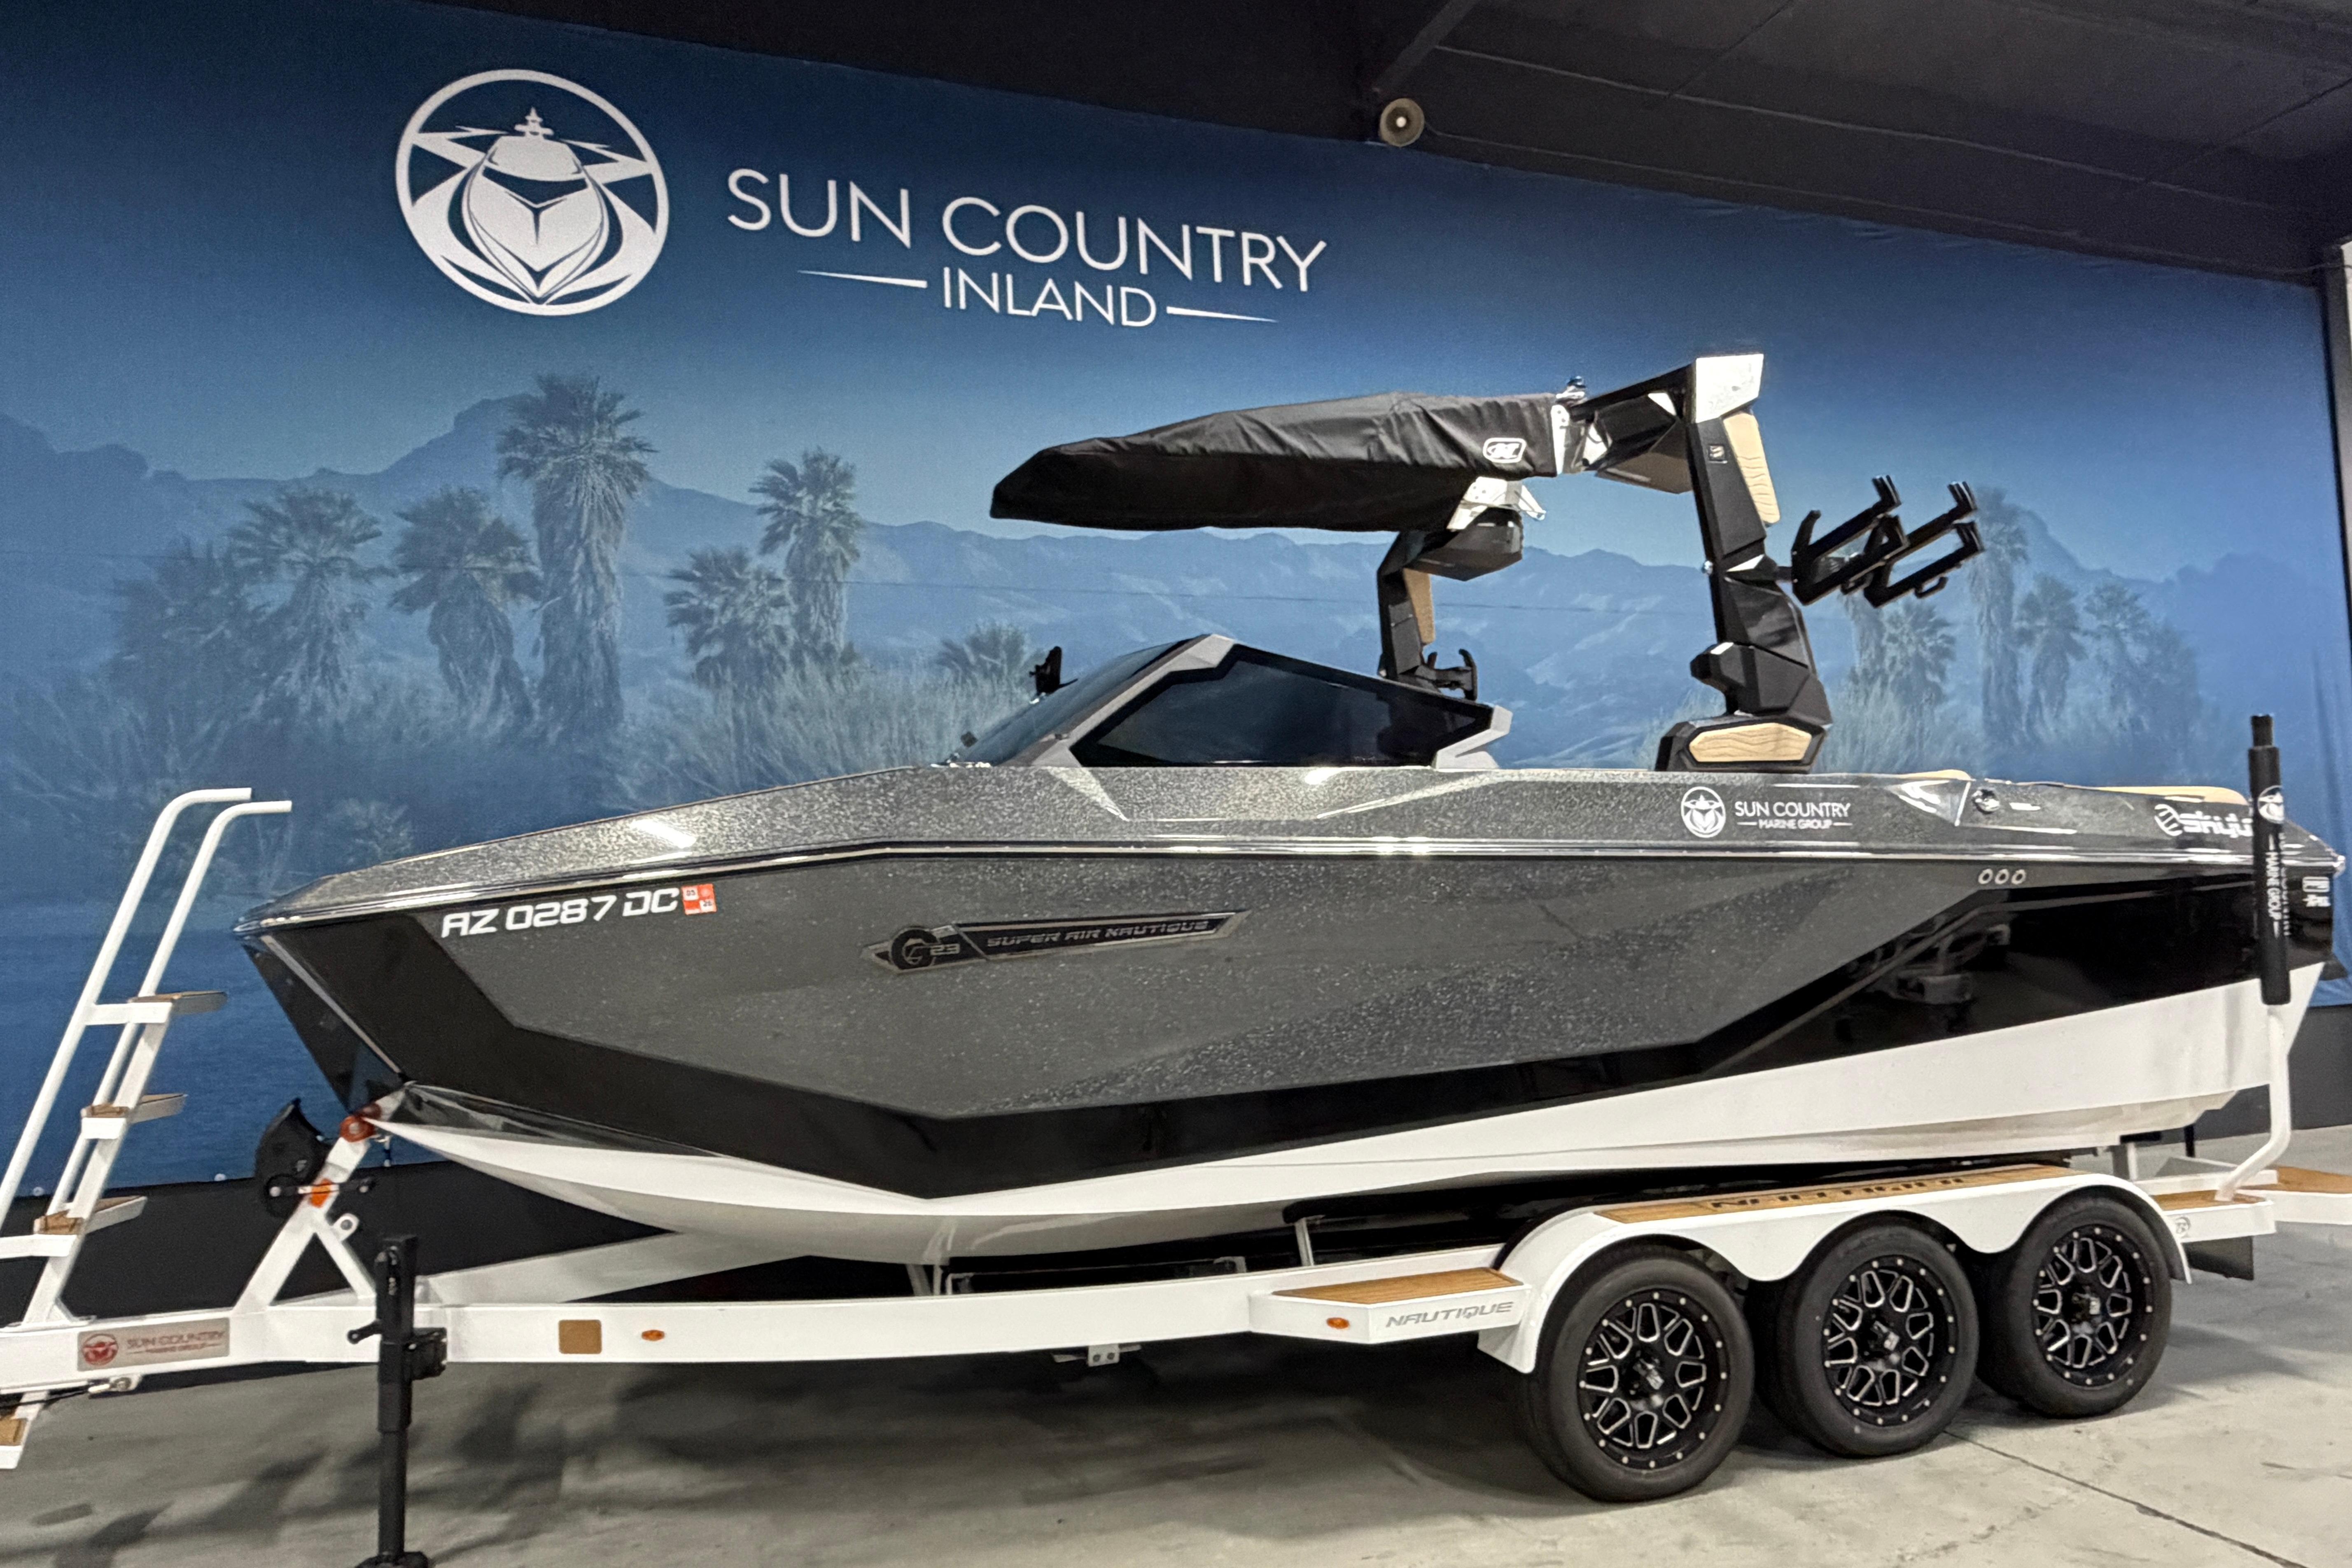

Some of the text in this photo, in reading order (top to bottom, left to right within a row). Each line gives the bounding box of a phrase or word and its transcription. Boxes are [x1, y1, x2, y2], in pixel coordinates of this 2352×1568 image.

[728, 169, 1327, 292] SUN COUNTRY
[943, 267, 1156, 327] INLAND
[1734, 801, 1851, 817] SUN COUNTRY
[441, 888, 680, 938] AZ 0287 DC
[987, 921, 1209, 947] SUPER AIR NAUTIQUE
[1386, 1301, 1514, 1328] NAUTIQUE
